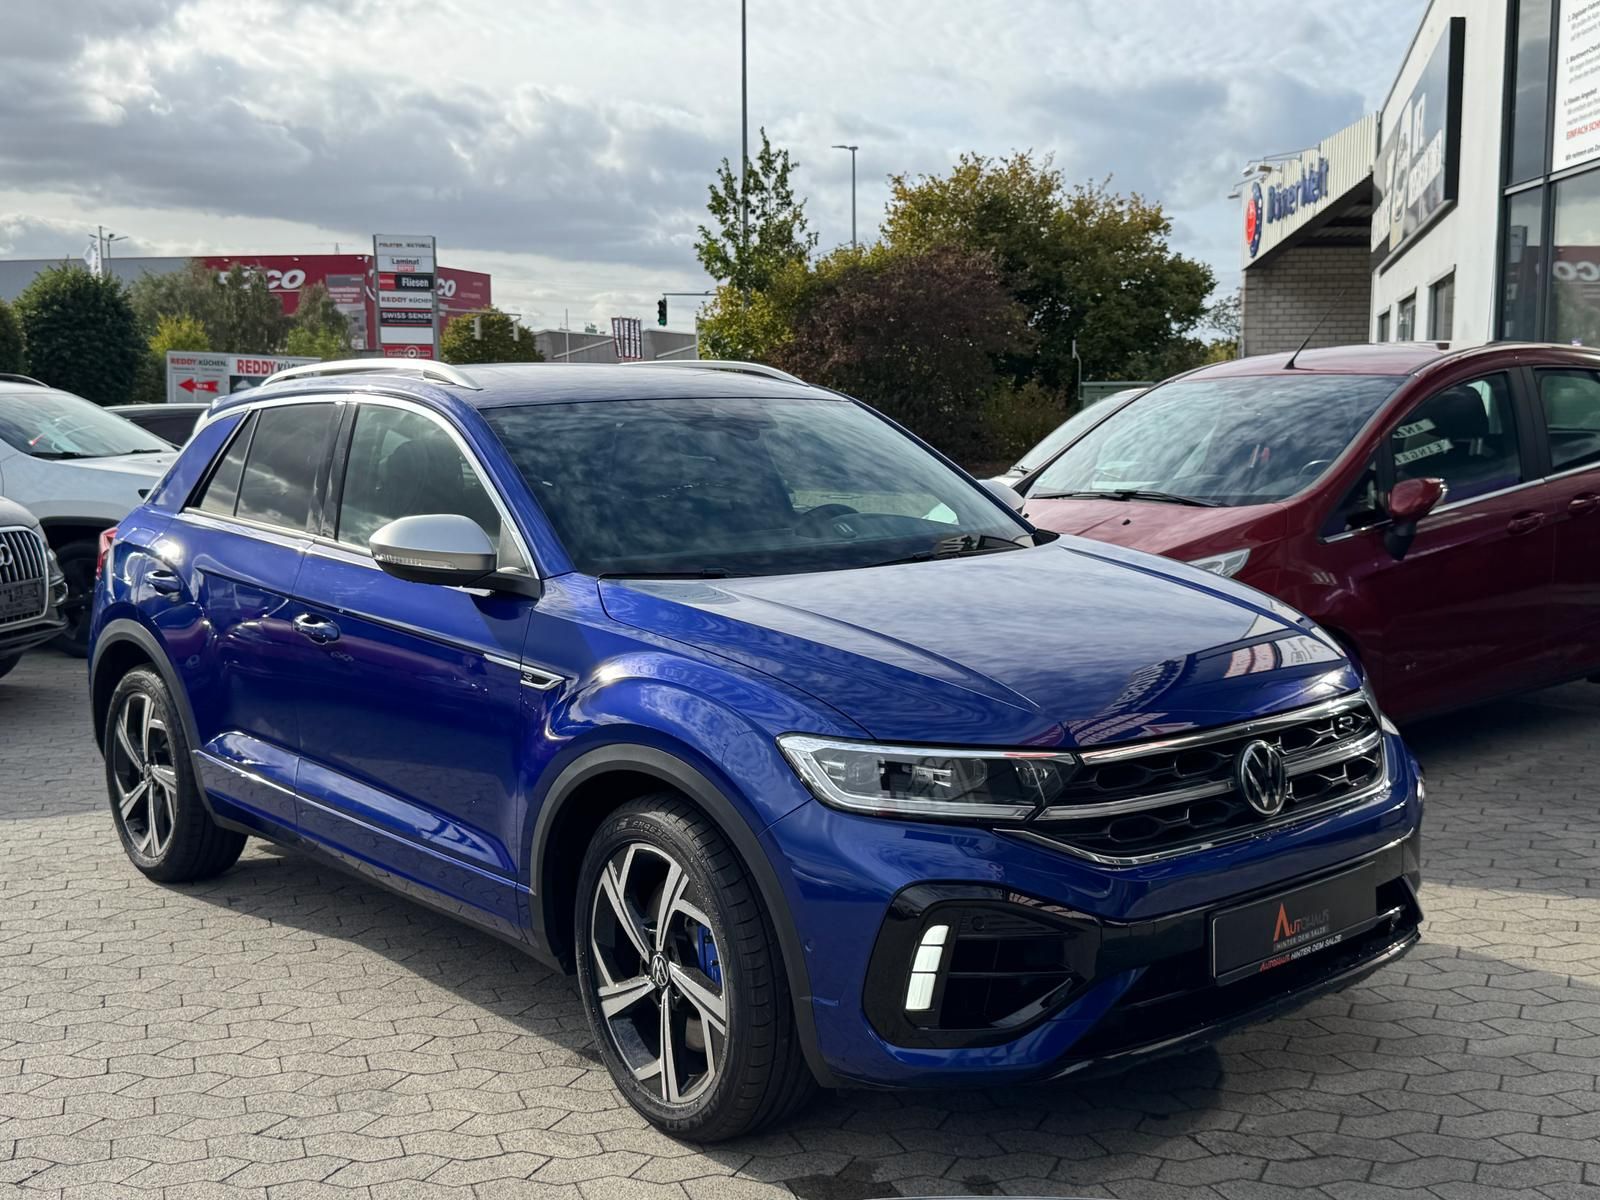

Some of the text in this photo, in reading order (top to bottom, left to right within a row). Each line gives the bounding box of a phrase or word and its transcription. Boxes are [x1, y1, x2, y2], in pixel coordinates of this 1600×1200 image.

[401, 278, 429, 287] Fliesen
[382, 312, 406, 320] SWISS
[237, 359, 276, 375] REDDY
[1290, 945, 1311, 960] HINTER
